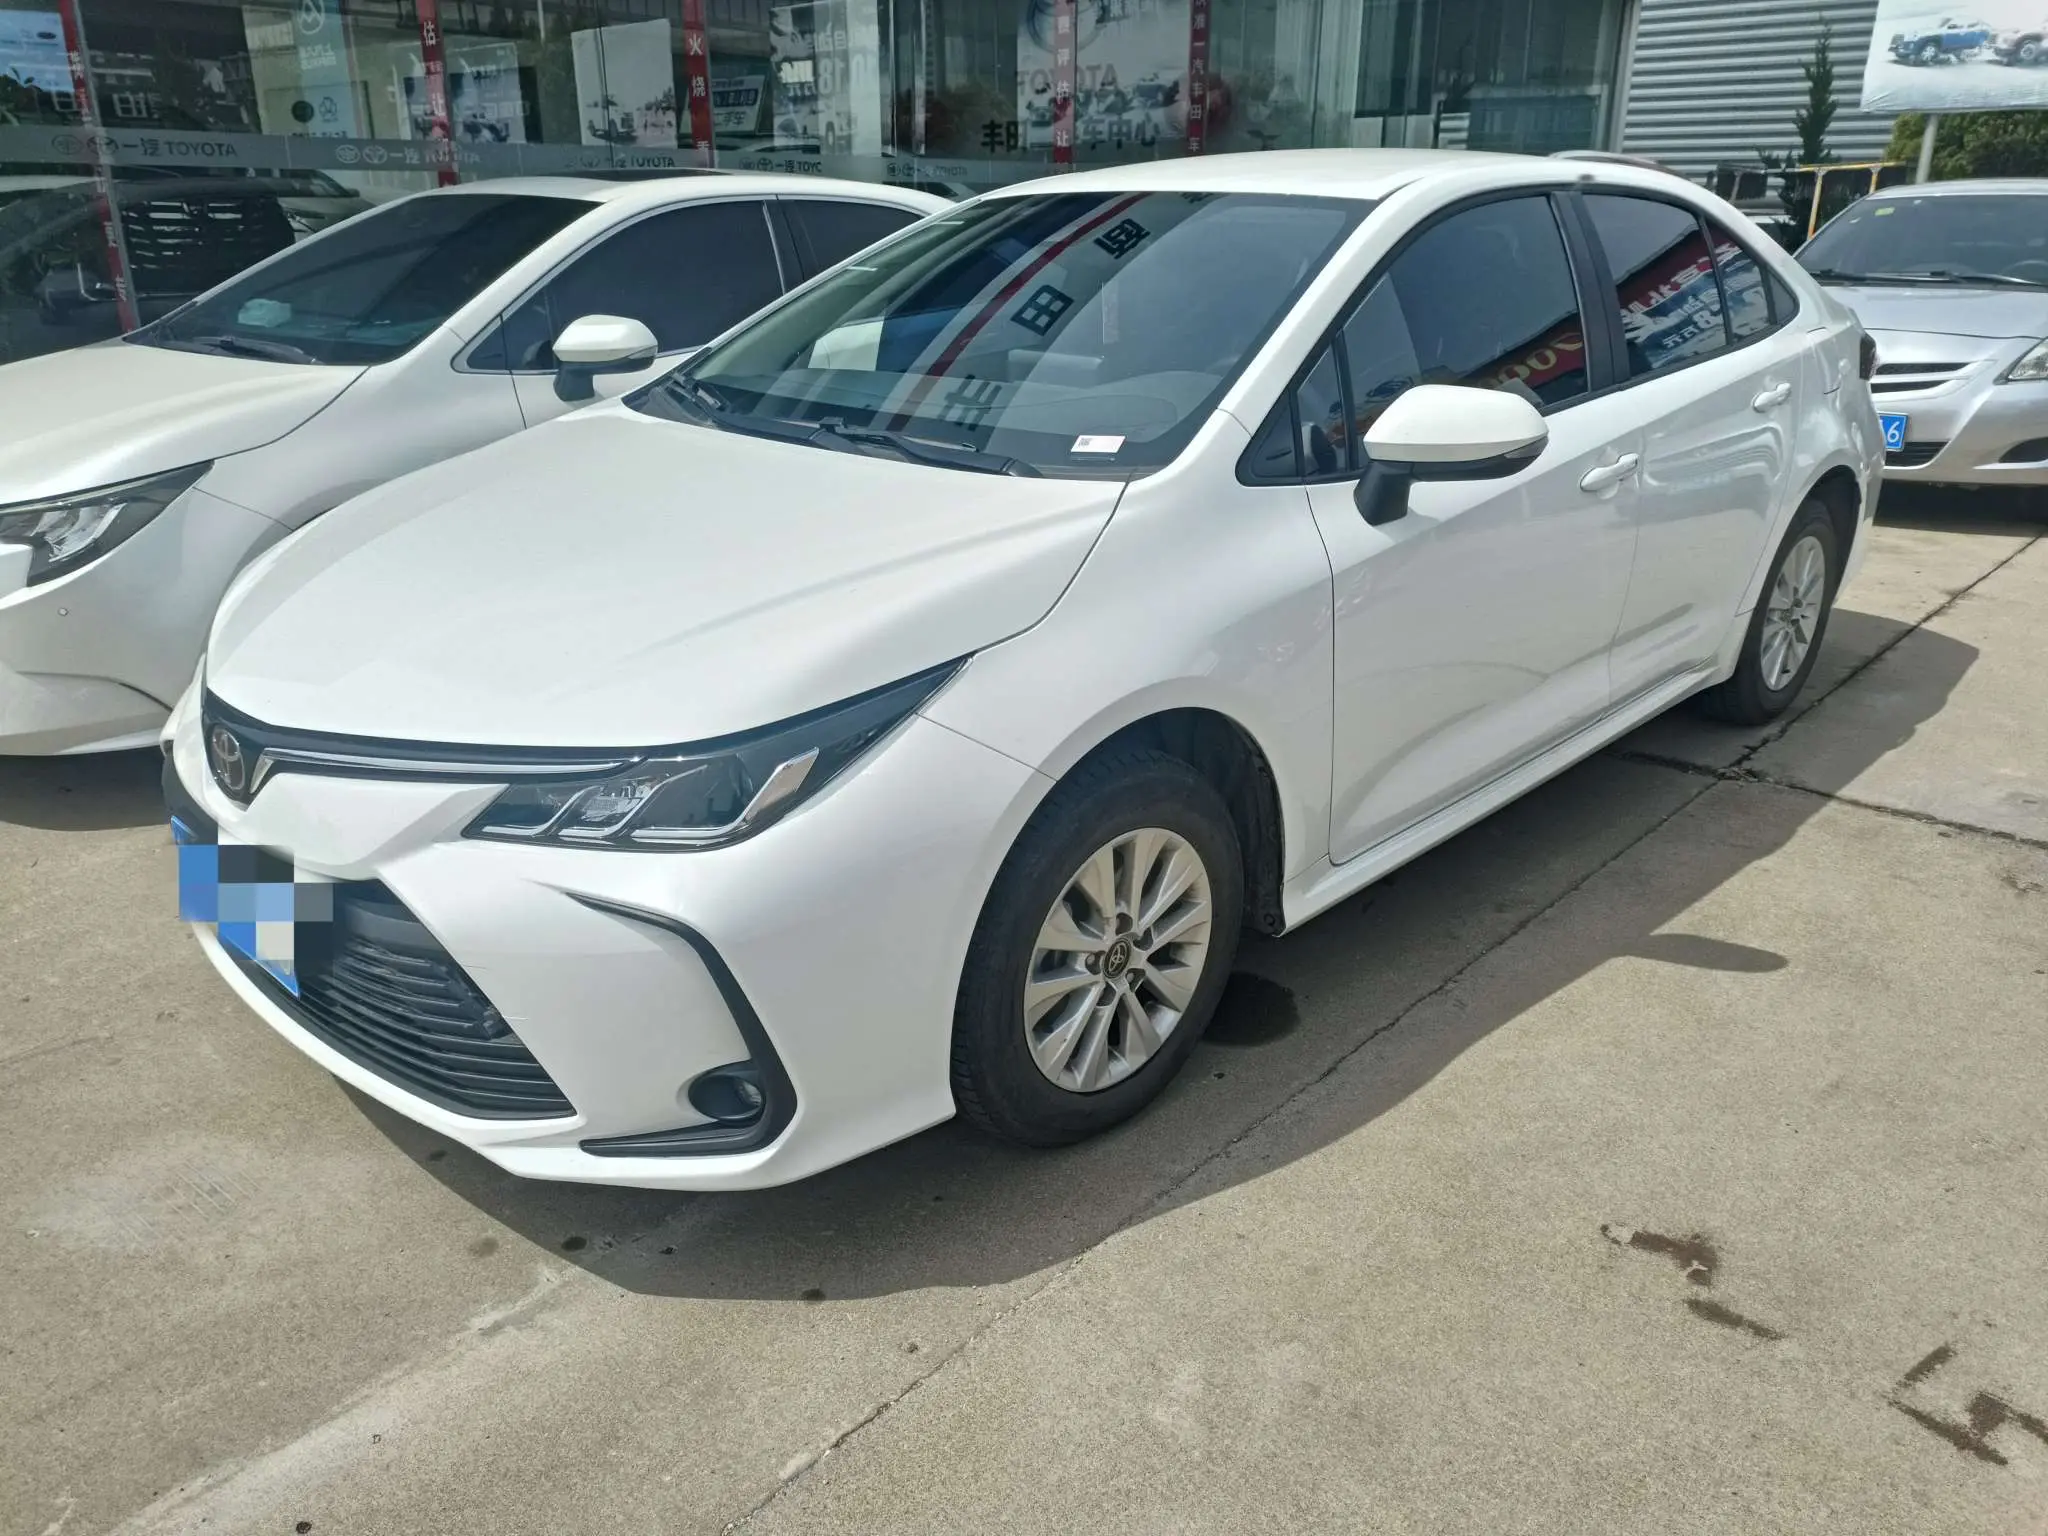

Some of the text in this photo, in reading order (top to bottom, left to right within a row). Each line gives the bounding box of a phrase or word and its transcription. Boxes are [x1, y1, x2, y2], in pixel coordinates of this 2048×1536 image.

[688, 32, 706, 97] 火烧
[163, 140, 238, 157] TOYOTA
[980, 116, 1161, 154] 丰田二车中心
